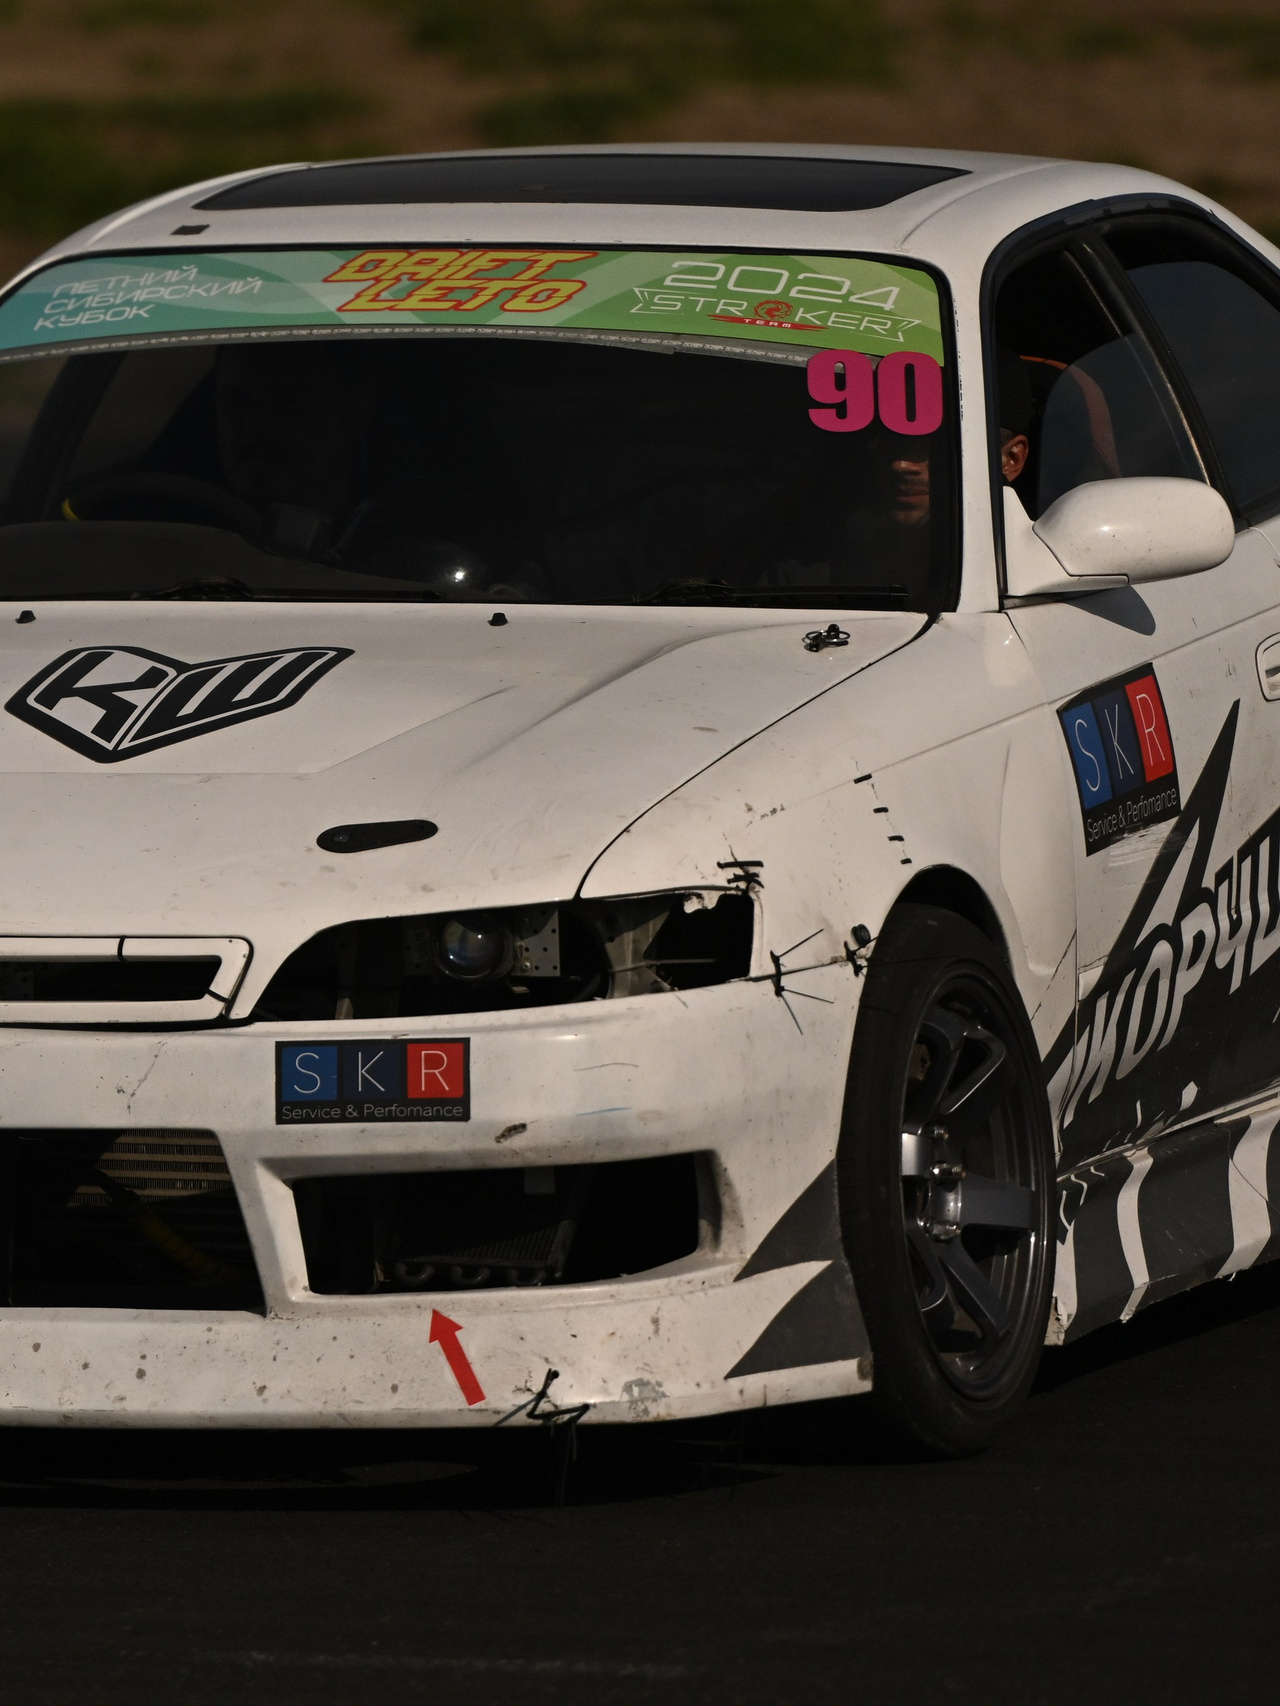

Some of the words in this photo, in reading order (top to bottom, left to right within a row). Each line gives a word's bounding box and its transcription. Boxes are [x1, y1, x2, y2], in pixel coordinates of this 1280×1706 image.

[52, 264, 198, 298] ЛЕТНИЙ
[322, 249, 599, 282] DRIFT
[43, 276, 263, 314] СИБИРСКИЙ
[336, 279, 587, 312] LETO
[663, 261, 900, 310] 2024
[33, 304, 155, 331] КУБОК
[806, 349, 944, 435] 90
[1074, 693, 1166, 792] SKR
[1086, 813, 1118, 842] Service
[1118, 805, 1127, 828] &
[293, 1050, 450, 1094] SKR
[282, 1105, 341, 1120] Service
[345, 1104, 359, 1118] &
[363, 1103, 464, 1118] Perfomance
